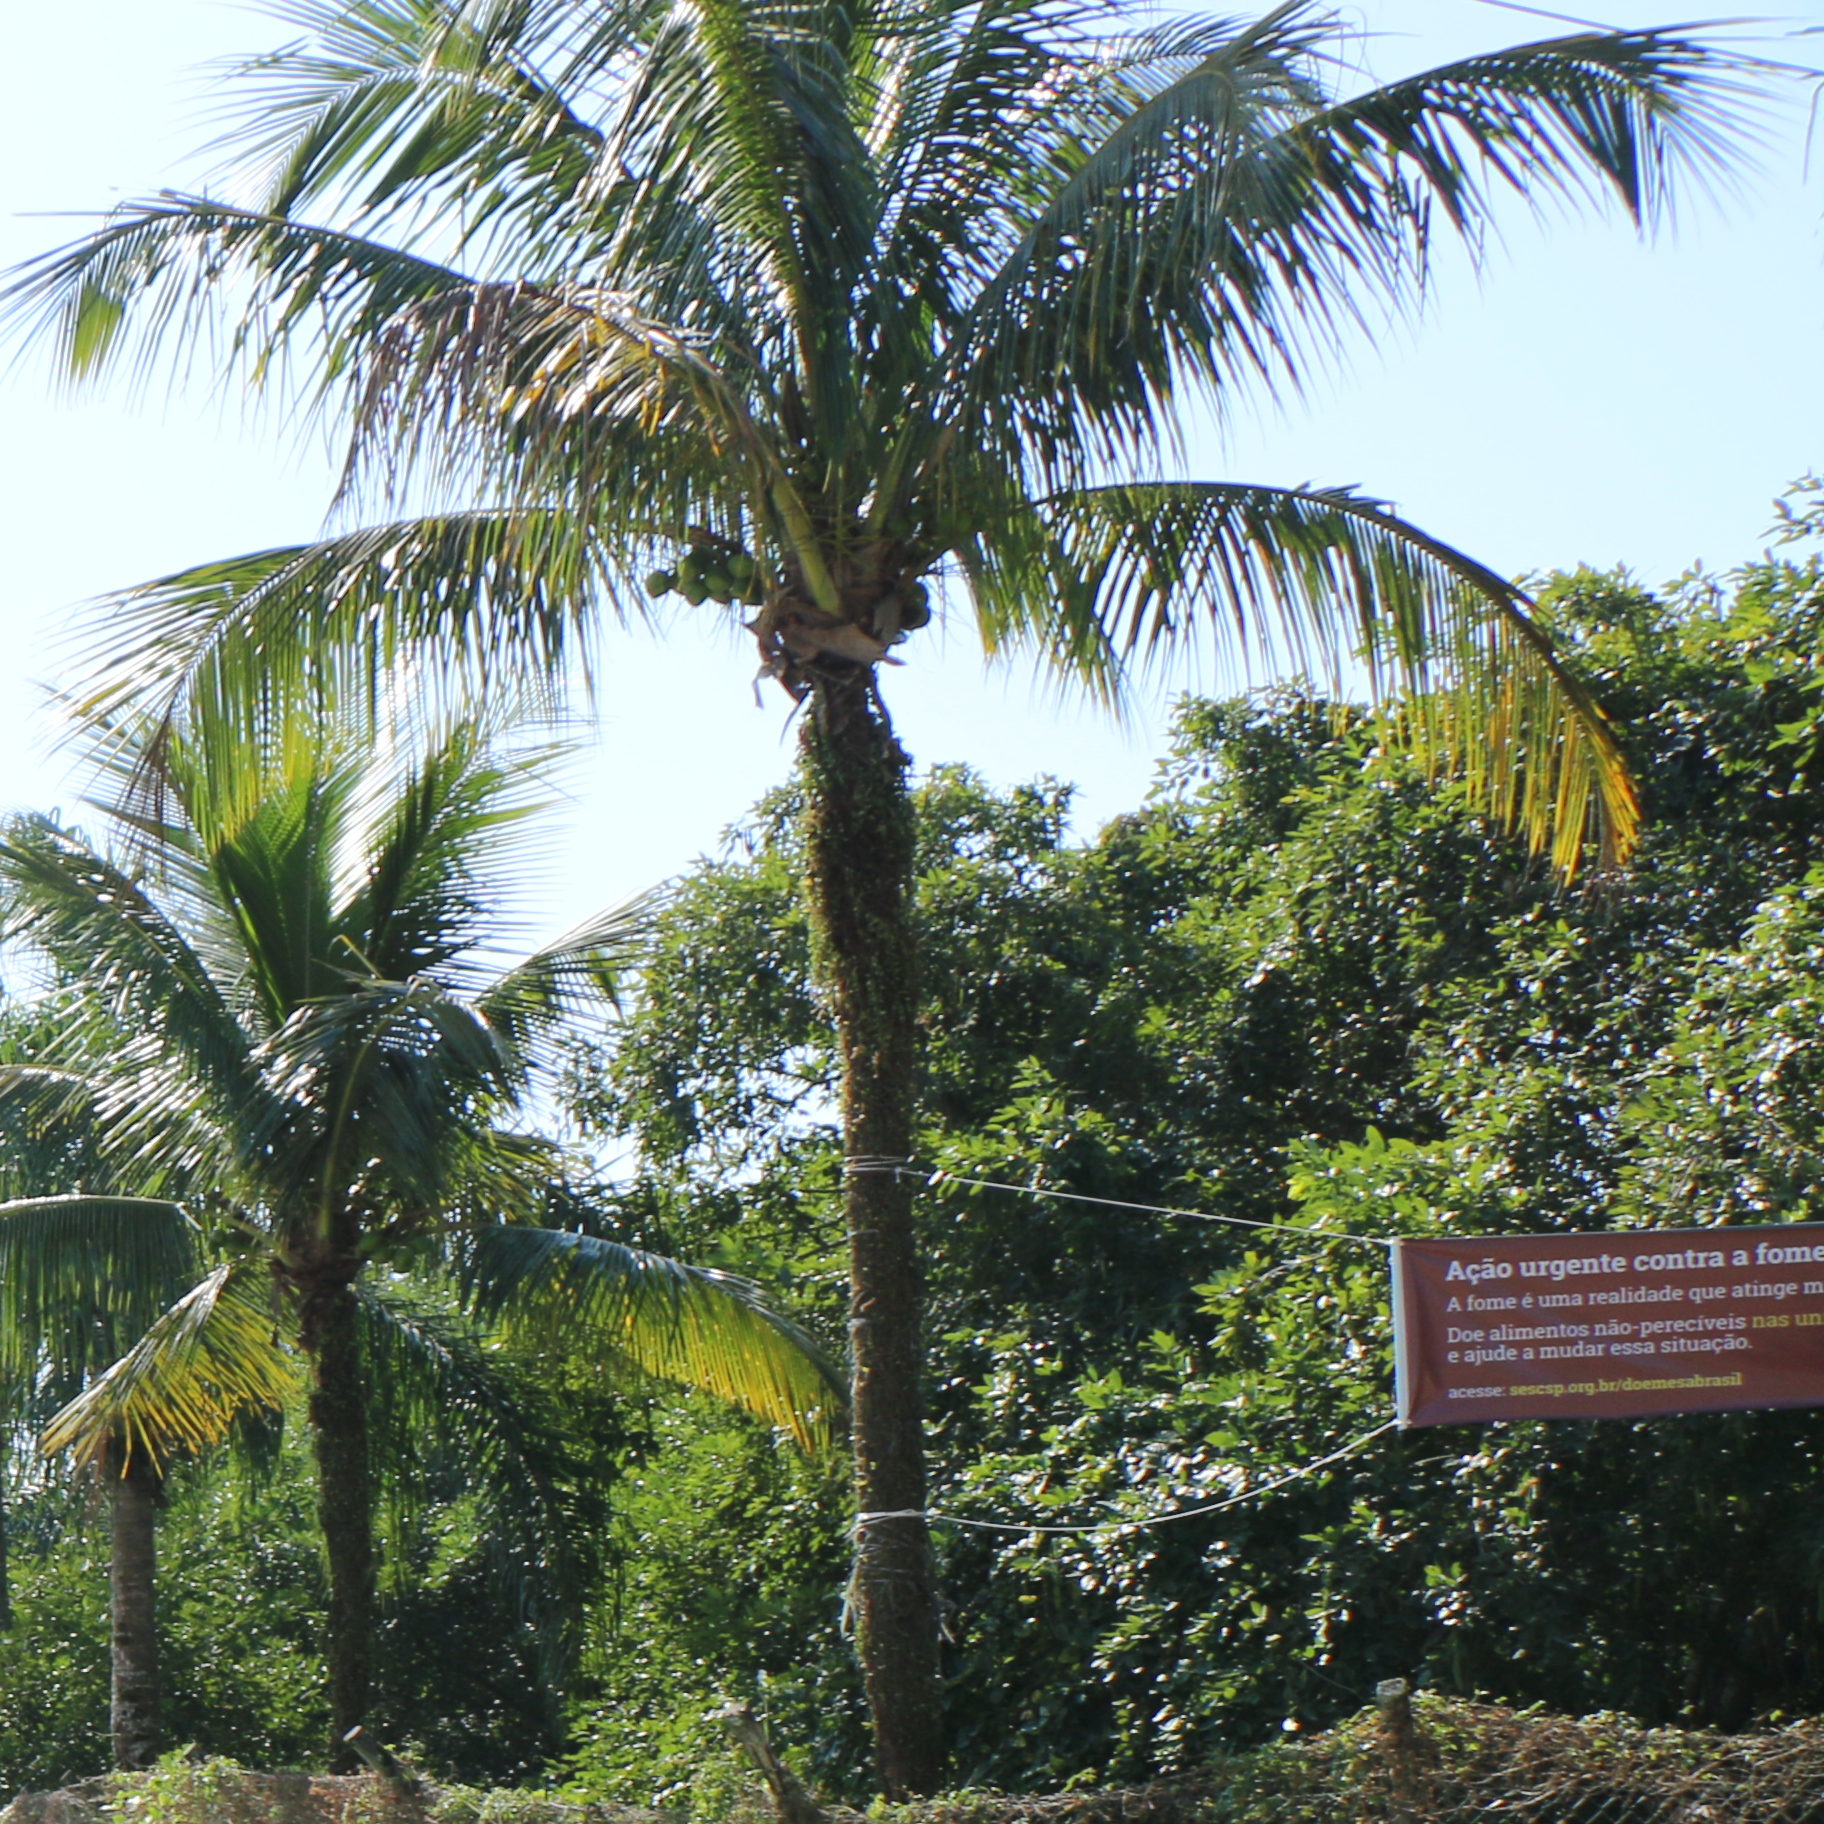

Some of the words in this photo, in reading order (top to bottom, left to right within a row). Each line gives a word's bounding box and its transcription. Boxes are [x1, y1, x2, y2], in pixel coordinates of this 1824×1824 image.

[1445, 1258, 1512, 1285] Ação
[1519, 1254, 1627, 1281] urgente
[1633, 1249, 1726, 1271] contra
[1732, 1249, 1749, 1266] a
[1755, 1242, 1824, 1265] fome
[1447, 1297, 1461, 1312] A
[1467, 1294, 1517, 1311] fome
[1521, 1293, 1533, 1308] é
[1538, 1294, 1583, 1307] uma
[1588, 1285, 1684, 1305] realidade
[1688, 1286, 1726, 1303] que
[1731, 1280, 1798, 1300] atinge
[1447, 1327, 1484, 1343] Doe
[1489, 1323, 1589, 1341] alimentos
[1594, 1313, 1746, 1338] não-perecíveis
[1752, 1315, 1790, 1328] nas
[1794, 1313, 1824, 1326] un
[1447, 1350, 1459, 1363] e
[1463, 1345, 1518, 1366] ajude
[1522, 1347, 1535, 1360] a
[1539, 1340, 1606, 1359] mudar
[1610, 1342, 1655, 1355] essa
[1660, 1333, 1753, 1354] situação.
[1448, 1386, 1506, 1398] acesse:
[1509, 1372, 1742, 1396] sescsp.org.br/doemesabrasil
